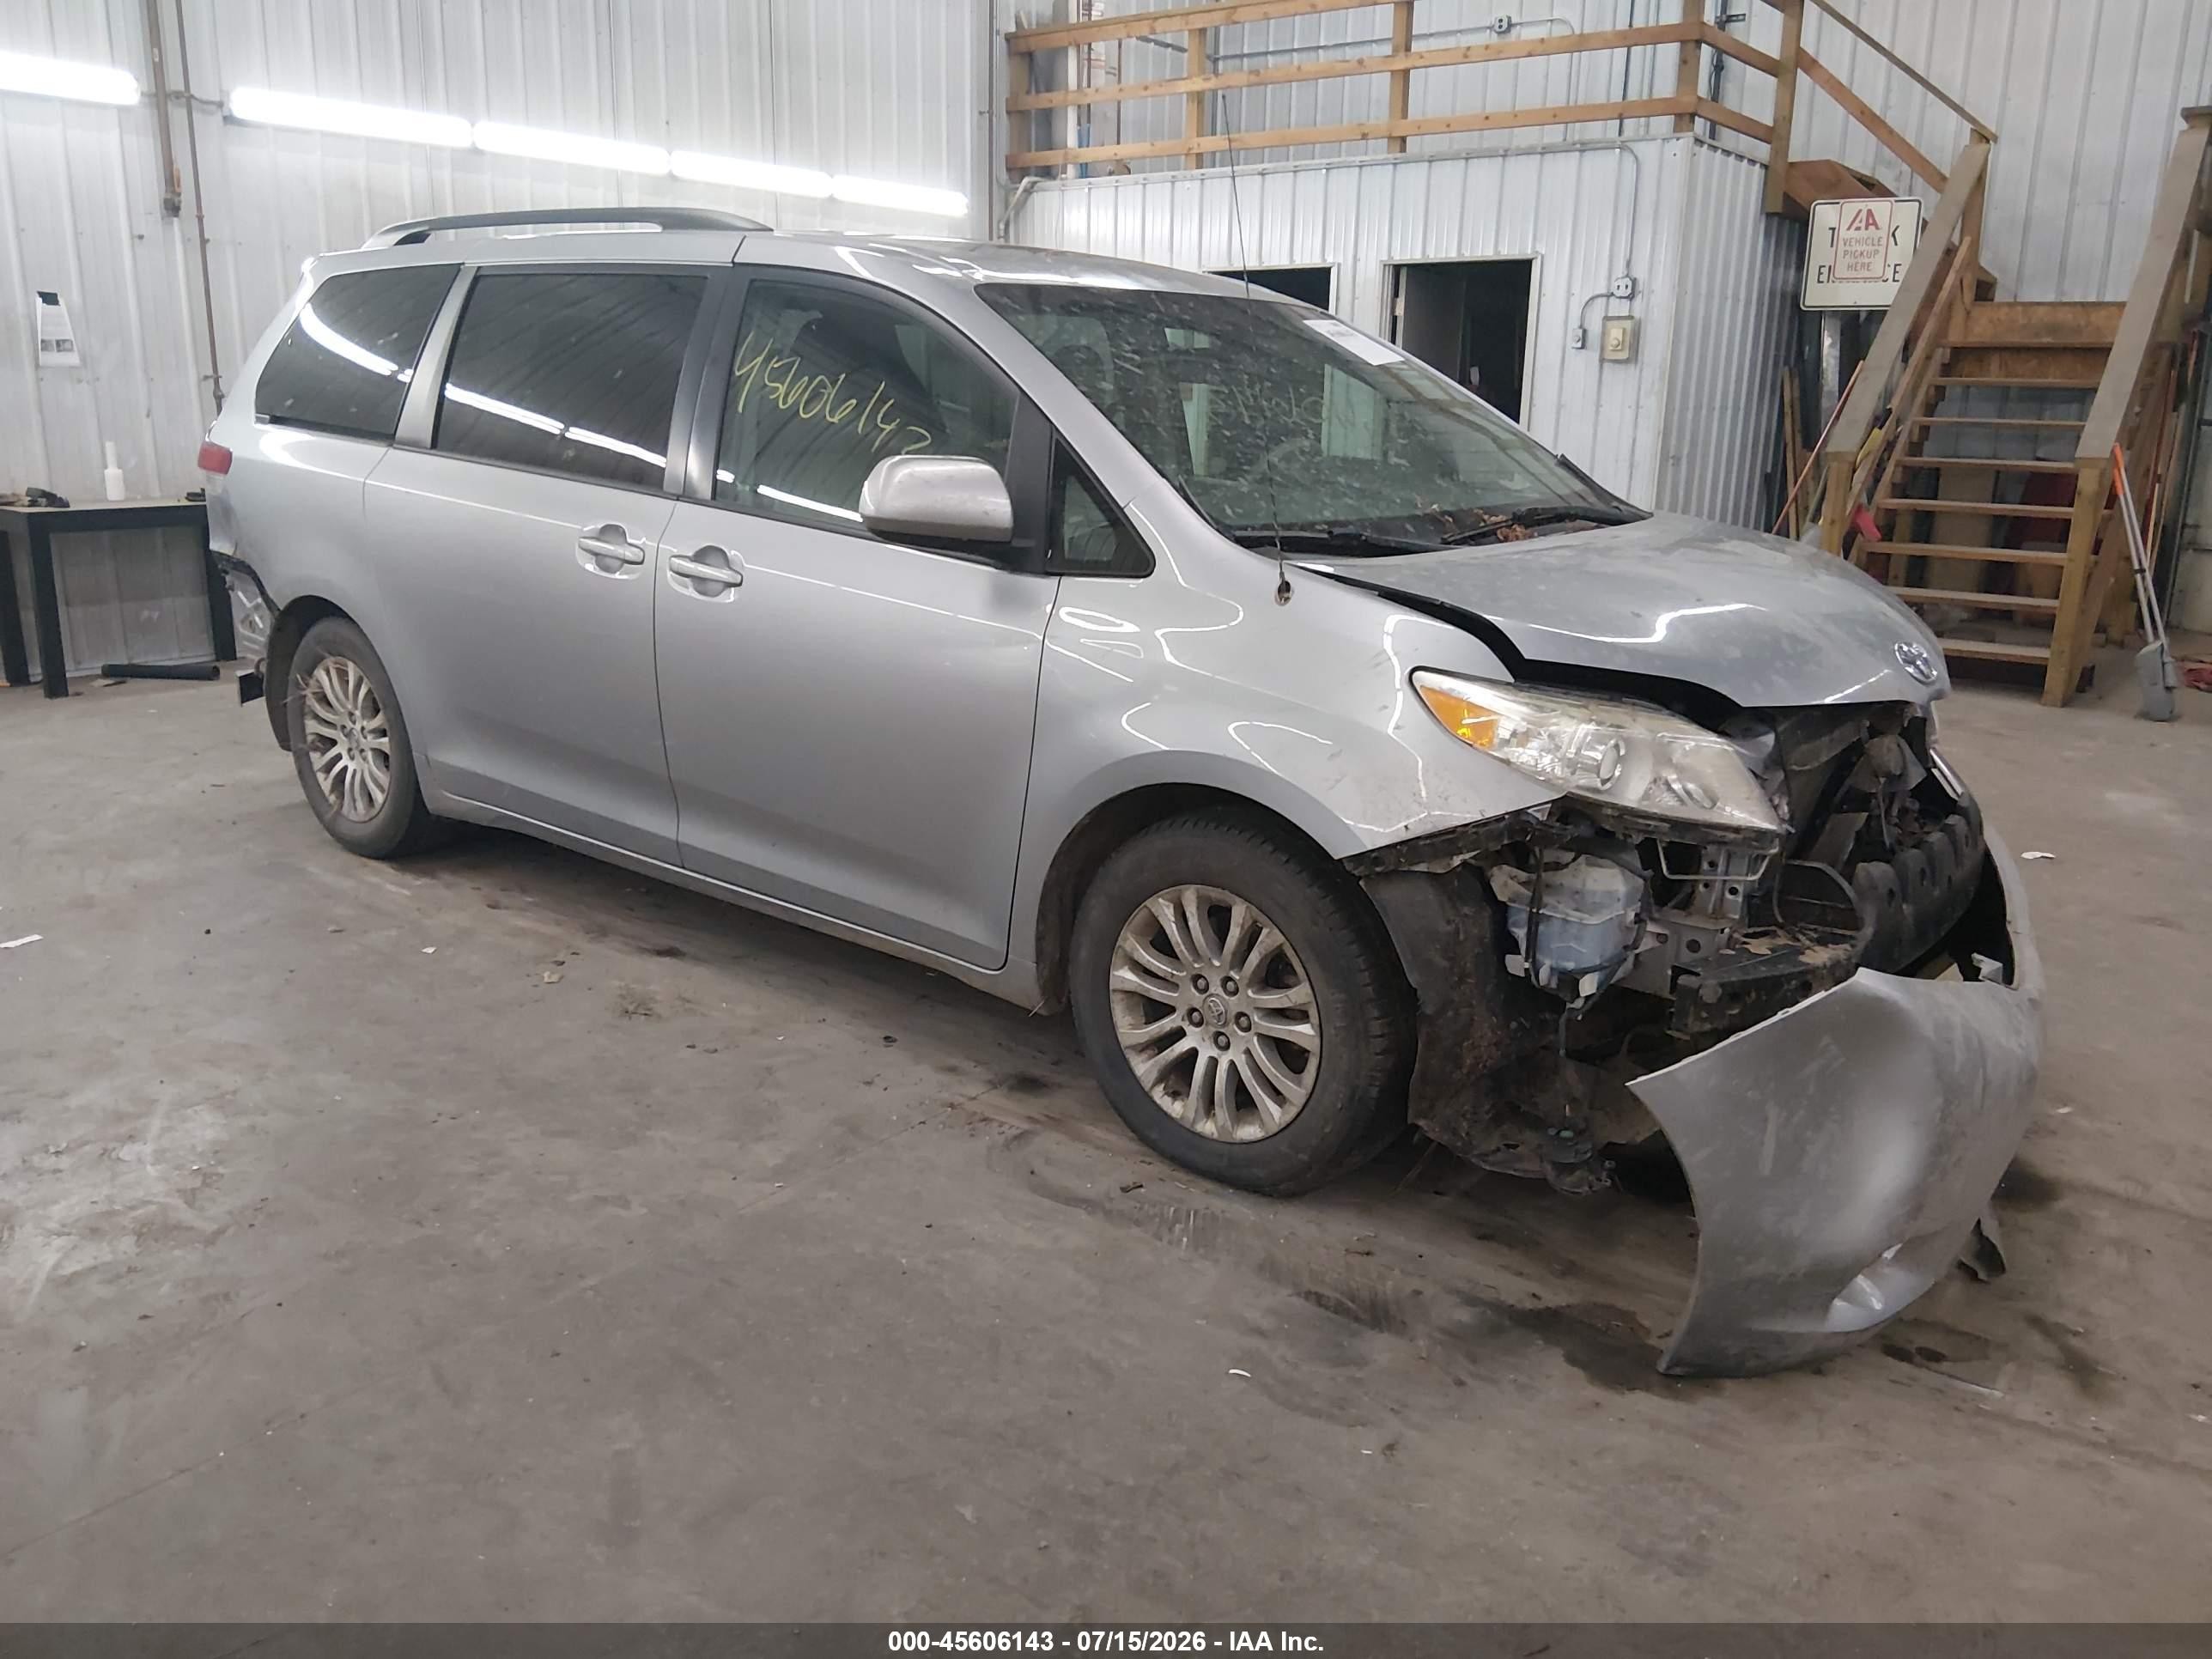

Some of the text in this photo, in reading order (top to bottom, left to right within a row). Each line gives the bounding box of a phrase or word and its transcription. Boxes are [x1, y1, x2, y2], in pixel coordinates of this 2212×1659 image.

[1843, 236, 1883, 247] VEHICLE
[1843, 248, 1881, 259] PICKUP
[1847, 261, 1873, 272] HERE
